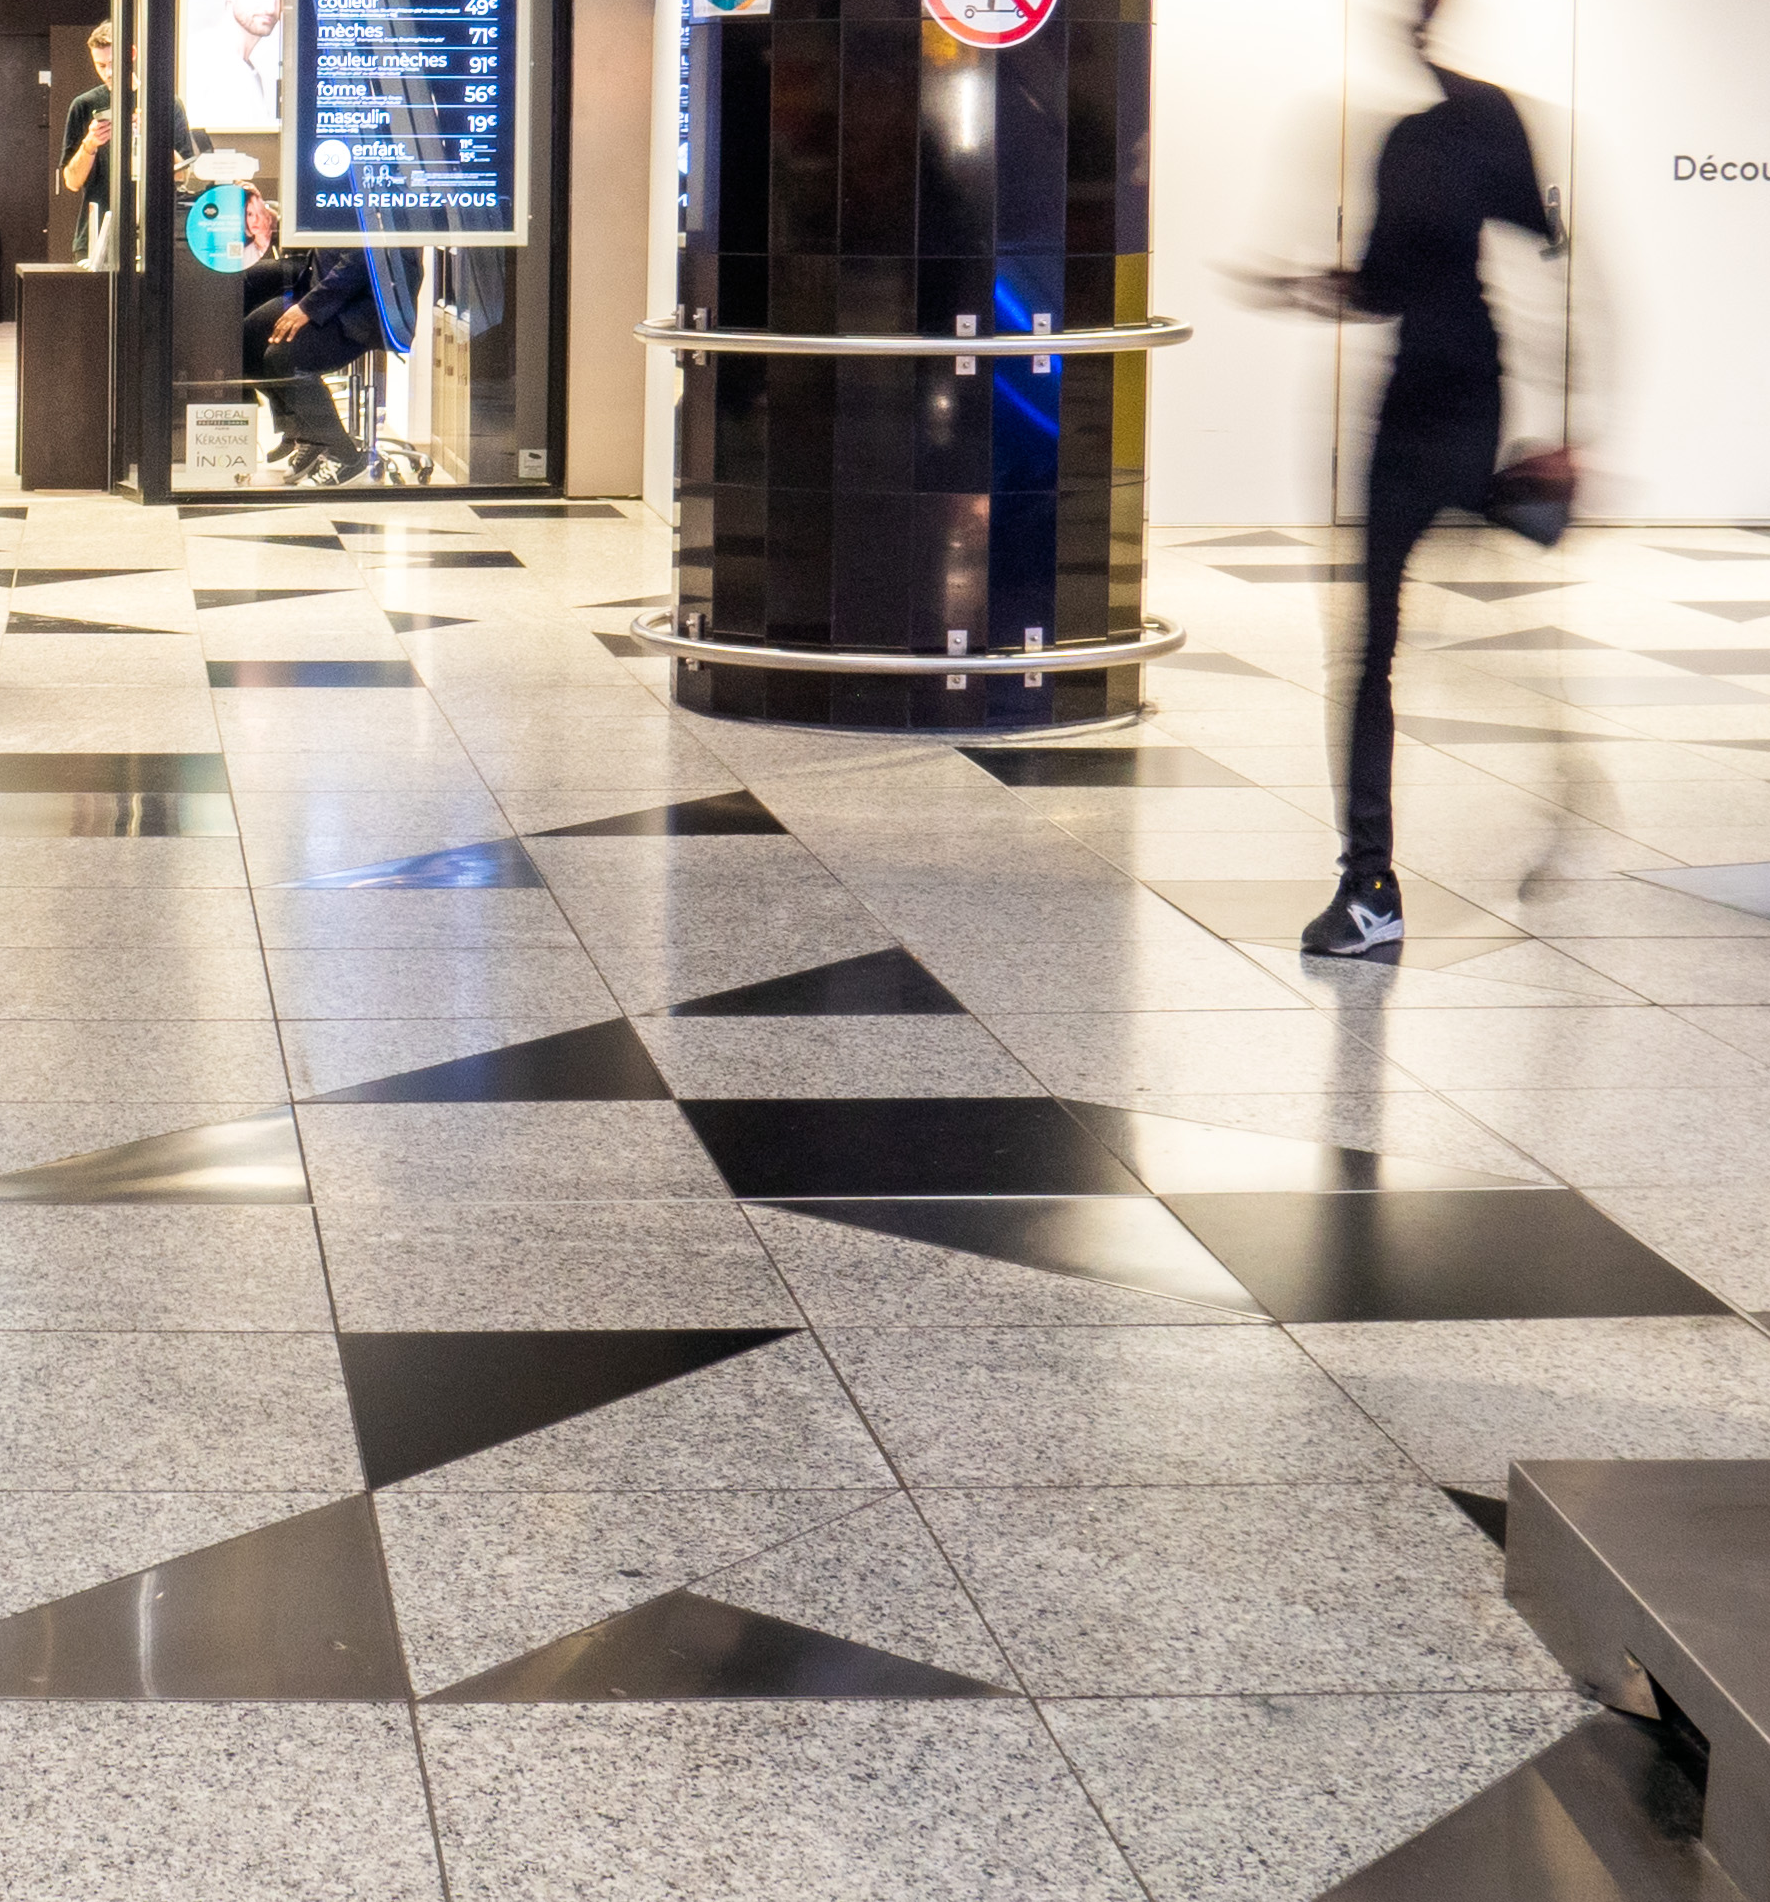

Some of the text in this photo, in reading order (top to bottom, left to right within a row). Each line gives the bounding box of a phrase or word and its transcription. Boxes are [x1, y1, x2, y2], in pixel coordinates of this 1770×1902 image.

[318, 23, 498, 45] mèches 71€
[317, 52, 498, 74] couleur mèches 91€
[317, 81, 497, 103] forme 56€
[317, 109, 497, 133] masculin 19€
[351, 140, 406, 157] enfant
[315, 193, 497, 208] SANS RENDEZ-VOUS
